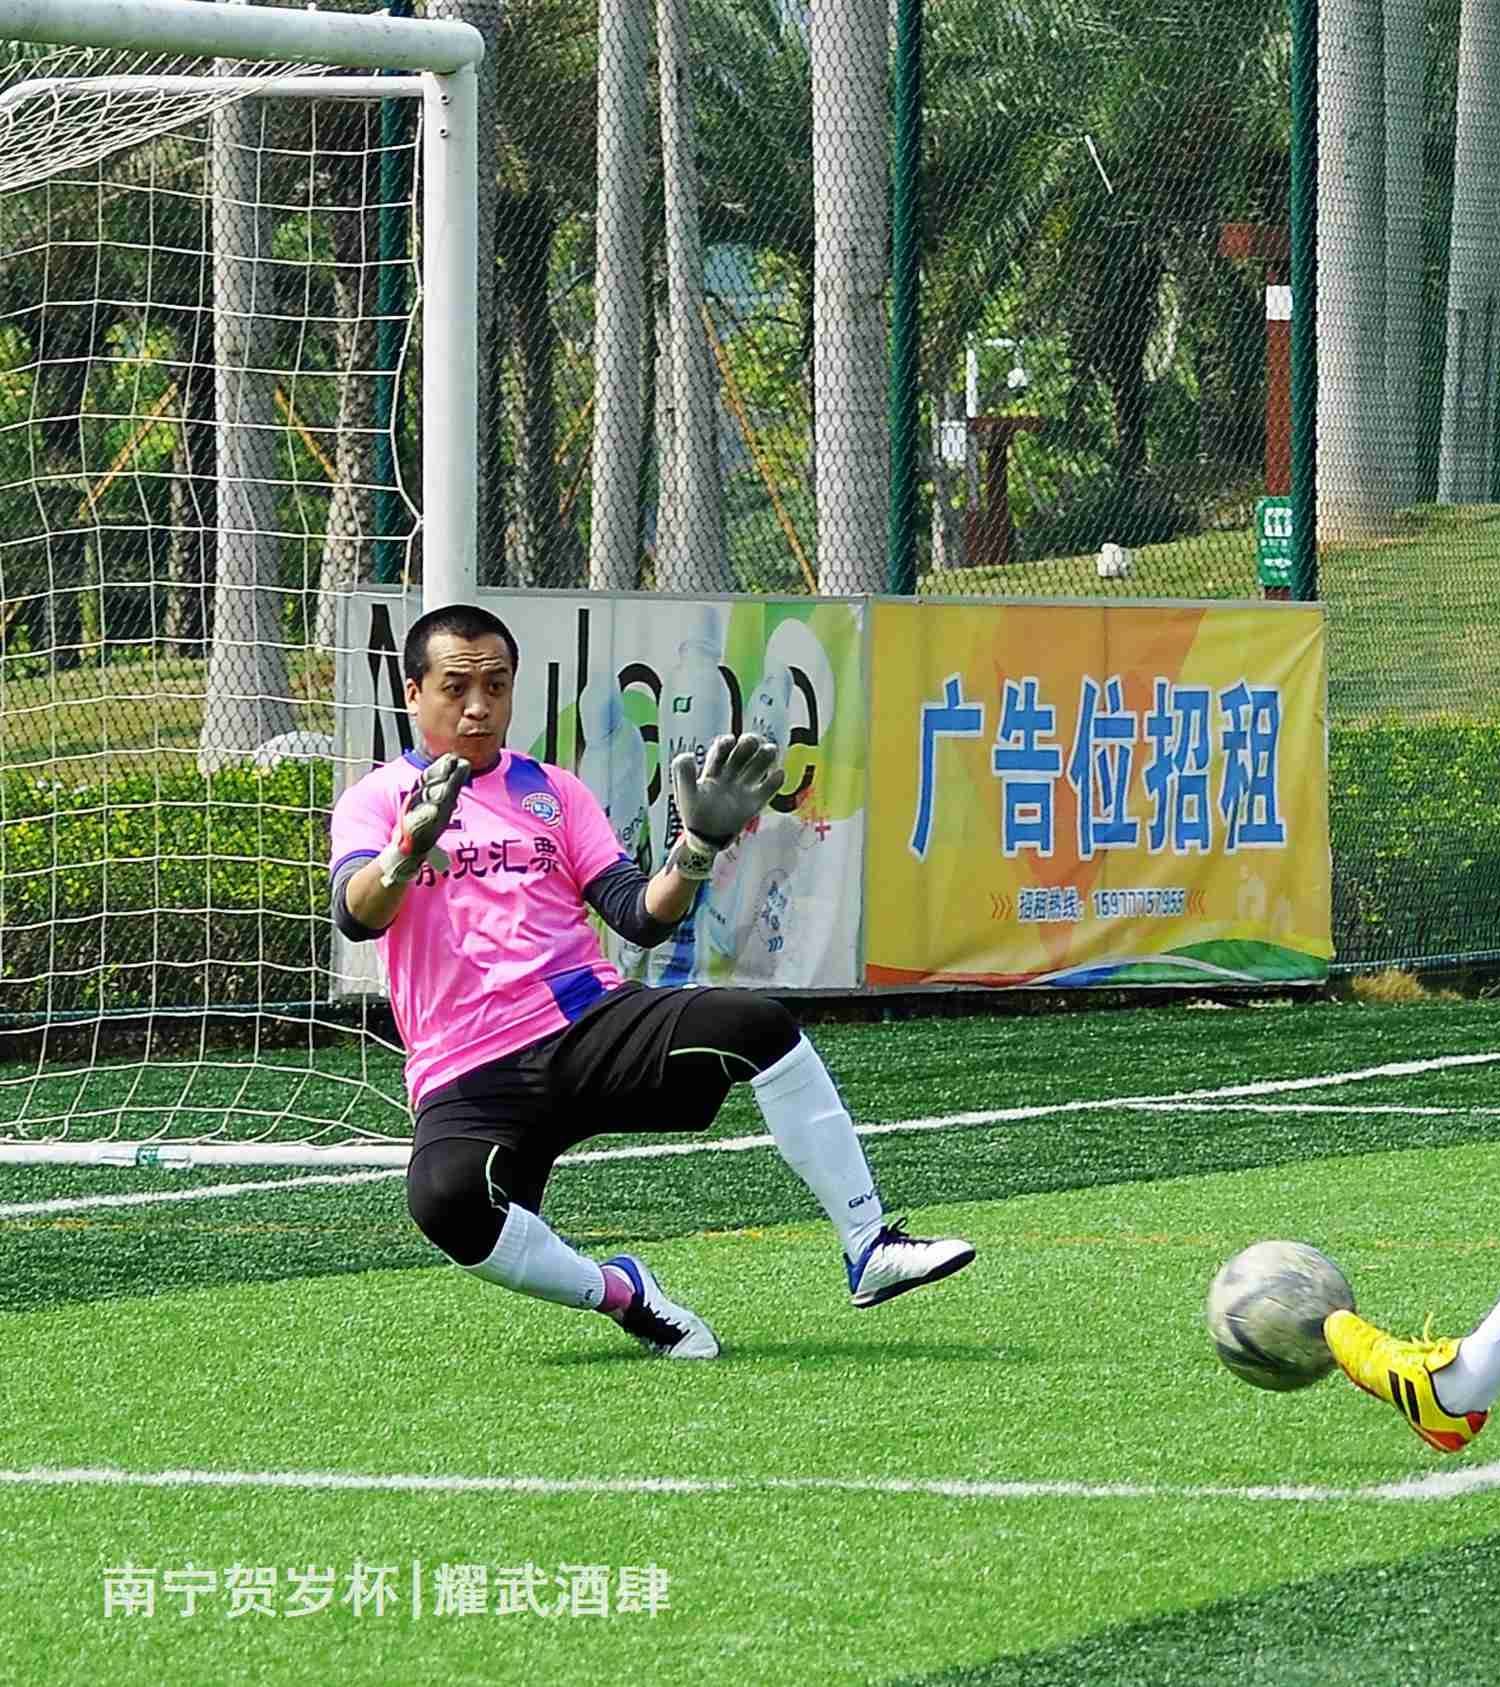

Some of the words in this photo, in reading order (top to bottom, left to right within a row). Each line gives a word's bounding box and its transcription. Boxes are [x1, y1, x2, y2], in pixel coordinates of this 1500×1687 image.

[909, 672, 1287, 861] 广告位招租
